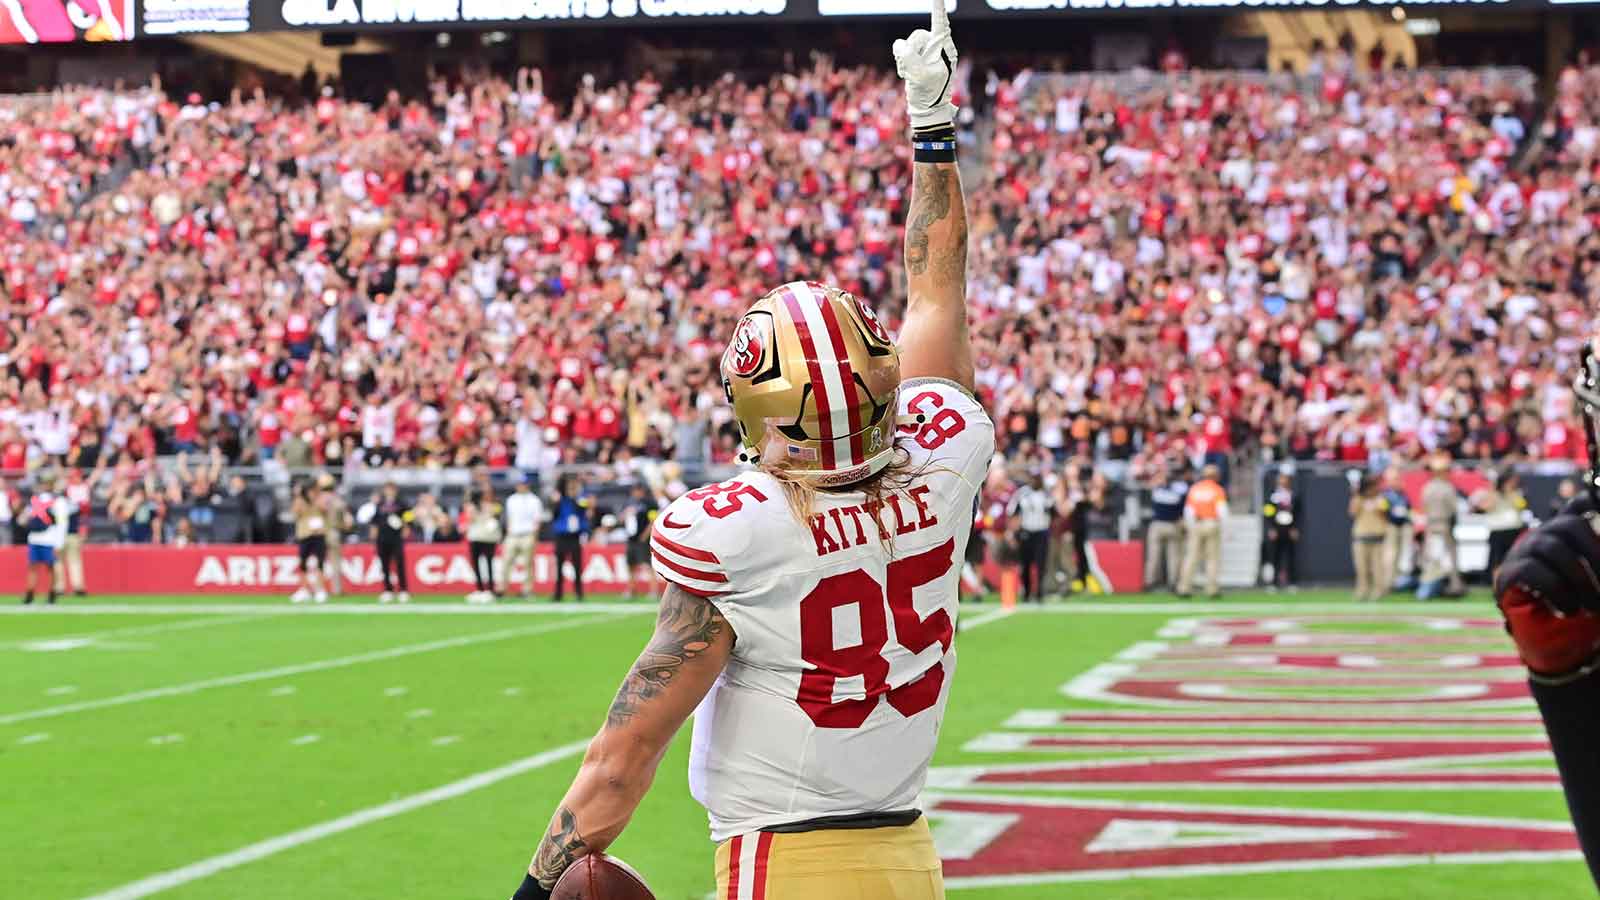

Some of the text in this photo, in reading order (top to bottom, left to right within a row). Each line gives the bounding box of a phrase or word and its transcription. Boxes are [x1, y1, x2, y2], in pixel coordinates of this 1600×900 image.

[685, 481, 769, 519] 85
[809, 484, 938, 556] KITTLE
[795, 536, 955, 728] 85
